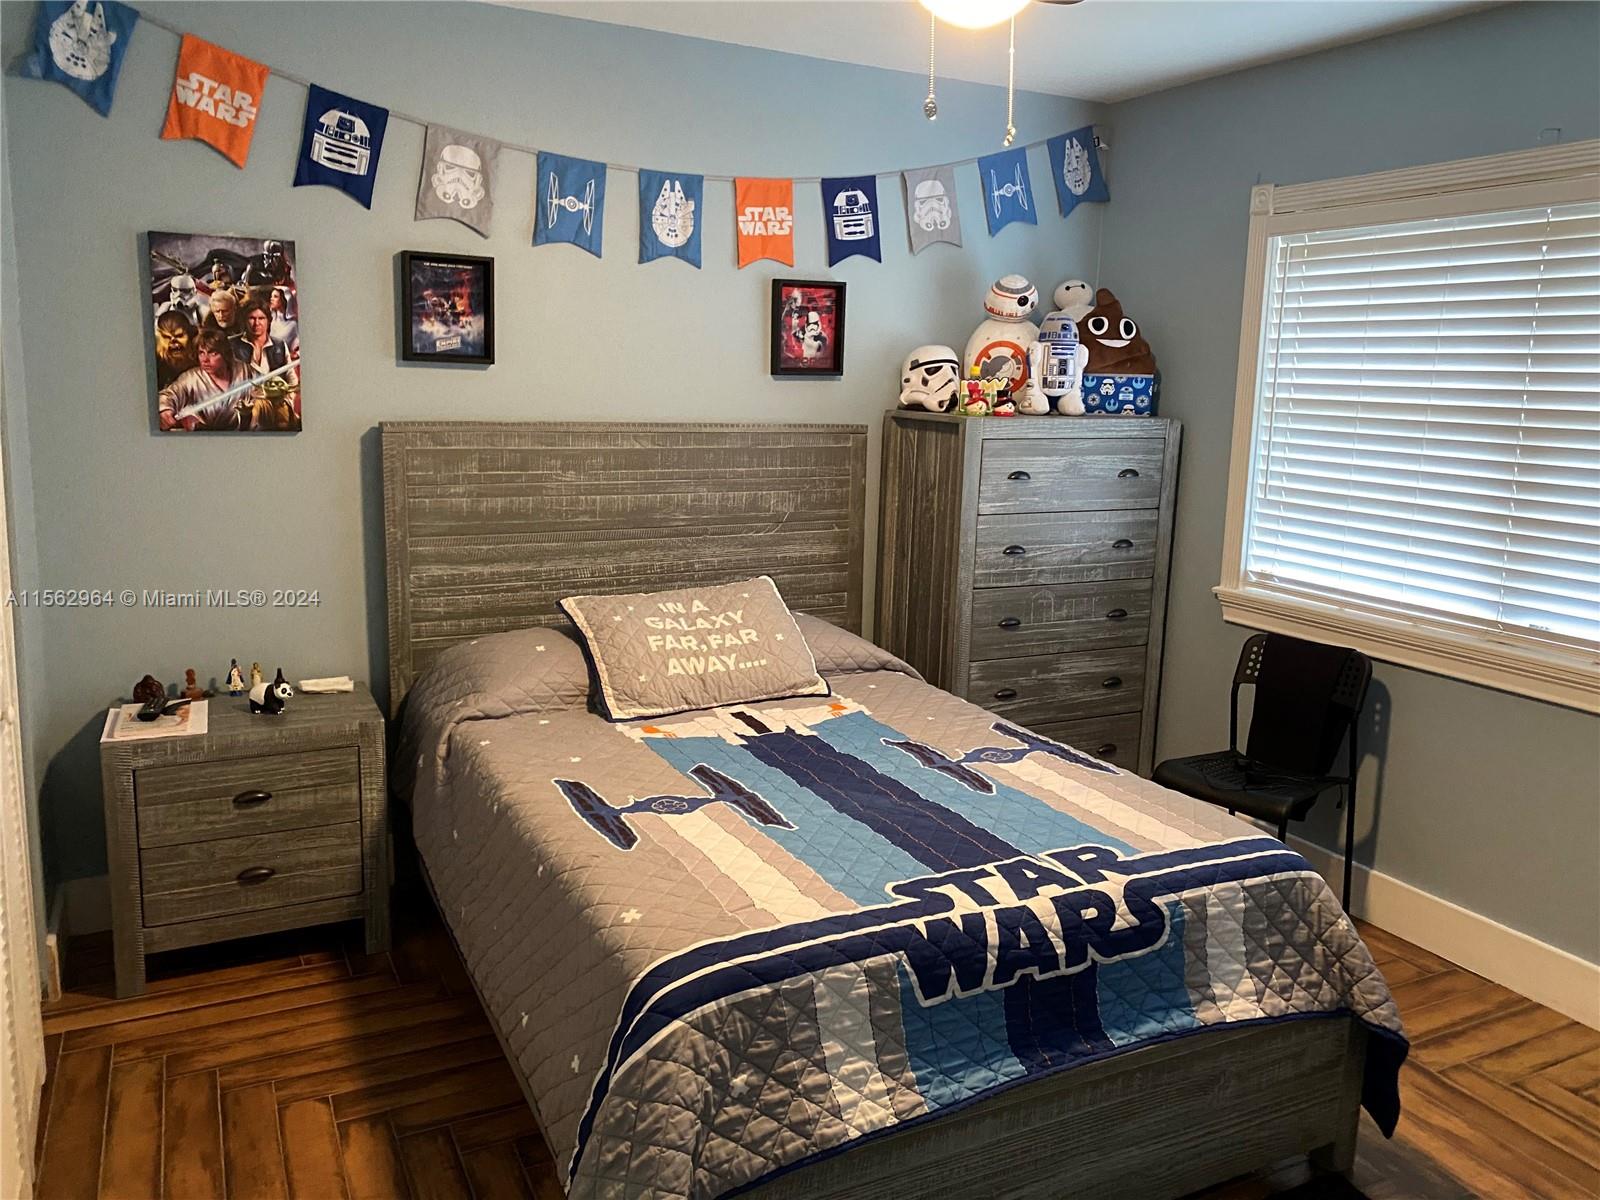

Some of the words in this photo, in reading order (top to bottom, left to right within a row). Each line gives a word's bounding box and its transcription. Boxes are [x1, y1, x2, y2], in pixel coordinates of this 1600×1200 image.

[176, 84, 256, 128] WARS
[177, 72, 257, 115] STAR
[738, 206, 793, 221] STAR
[738, 220, 793, 236] WARS
[644, 609, 744, 631] GALAXY
[657, 602, 687, 614] IN
[691, 599, 711, 614] A
[884, 844, 1125, 914] STAR
[895, 875, 1171, 1007] WARS
